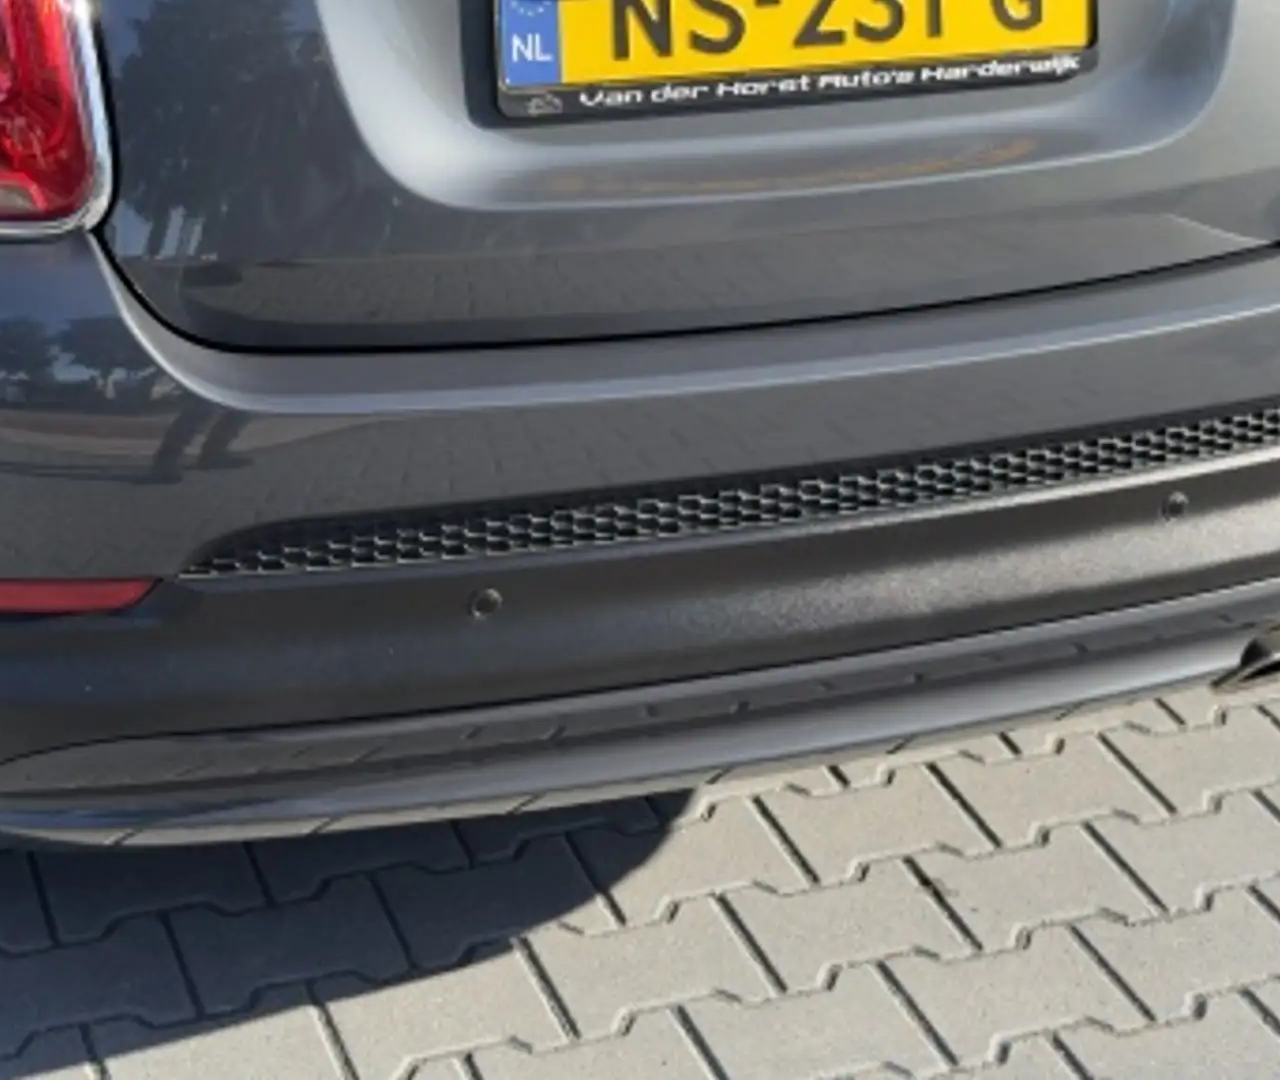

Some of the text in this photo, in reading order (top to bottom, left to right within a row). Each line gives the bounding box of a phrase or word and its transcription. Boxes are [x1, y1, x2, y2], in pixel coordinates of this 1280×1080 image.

[511, 33, 552, 63] NL
[579, 54, 1081, 108] Van der Horst Auto's Harderwijk
